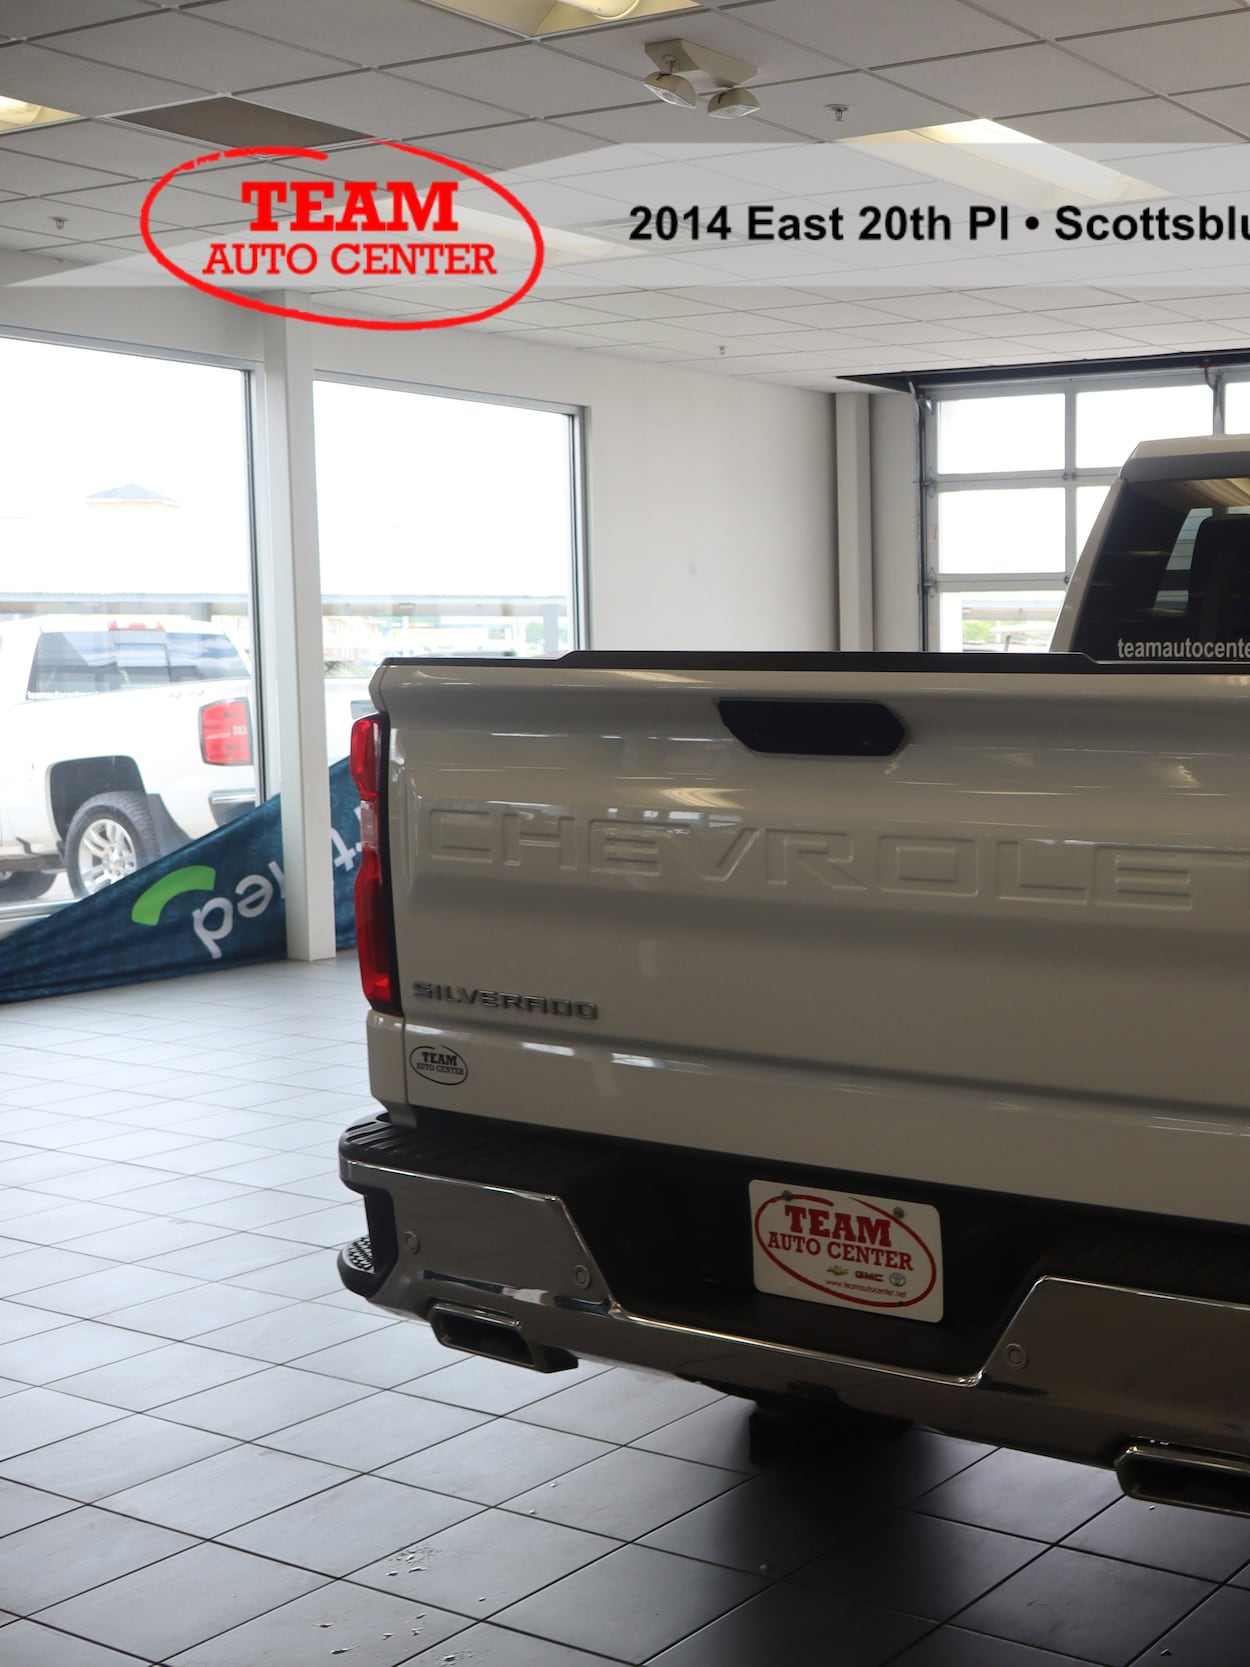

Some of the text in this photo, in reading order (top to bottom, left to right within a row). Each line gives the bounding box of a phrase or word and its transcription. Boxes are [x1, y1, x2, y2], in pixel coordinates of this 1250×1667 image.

[412, 980, 599, 1021] SILVERADO
[422, 1051, 458, 1067] TEAM
[785, 1205, 892, 1248] TEAM
[767, 1231, 914, 1272] AUTO CENTER
[855, 1270, 884, 1283] GMC
